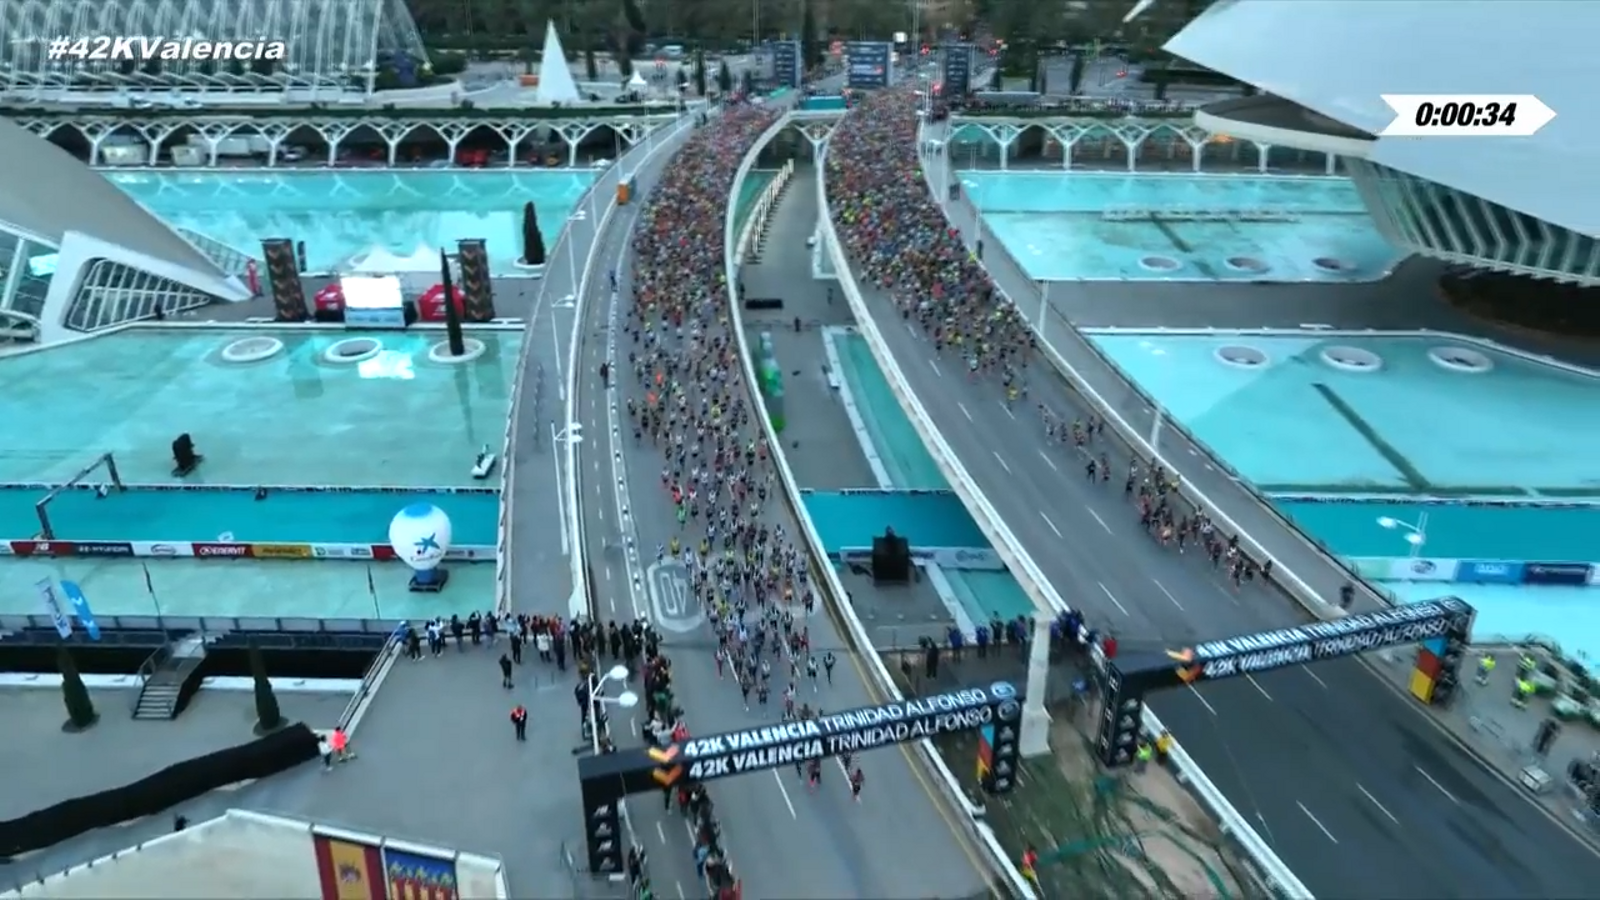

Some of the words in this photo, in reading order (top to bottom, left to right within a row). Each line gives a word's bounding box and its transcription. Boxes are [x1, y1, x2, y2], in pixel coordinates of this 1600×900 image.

[1226, 627, 1304, 651] VALENCIA
[685, 735, 726, 758] 42K
[726, 719, 822, 750] VALENCIA
[819, 704, 905, 733] TRINIDAD
[905, 688, 988, 718] ALFONSO
[689, 755, 731, 779] 42K
[732, 739, 824, 774] VALENCIA
[827, 722, 909, 753] TRINIDAD
[910, 705, 992, 737] ALFONSO
